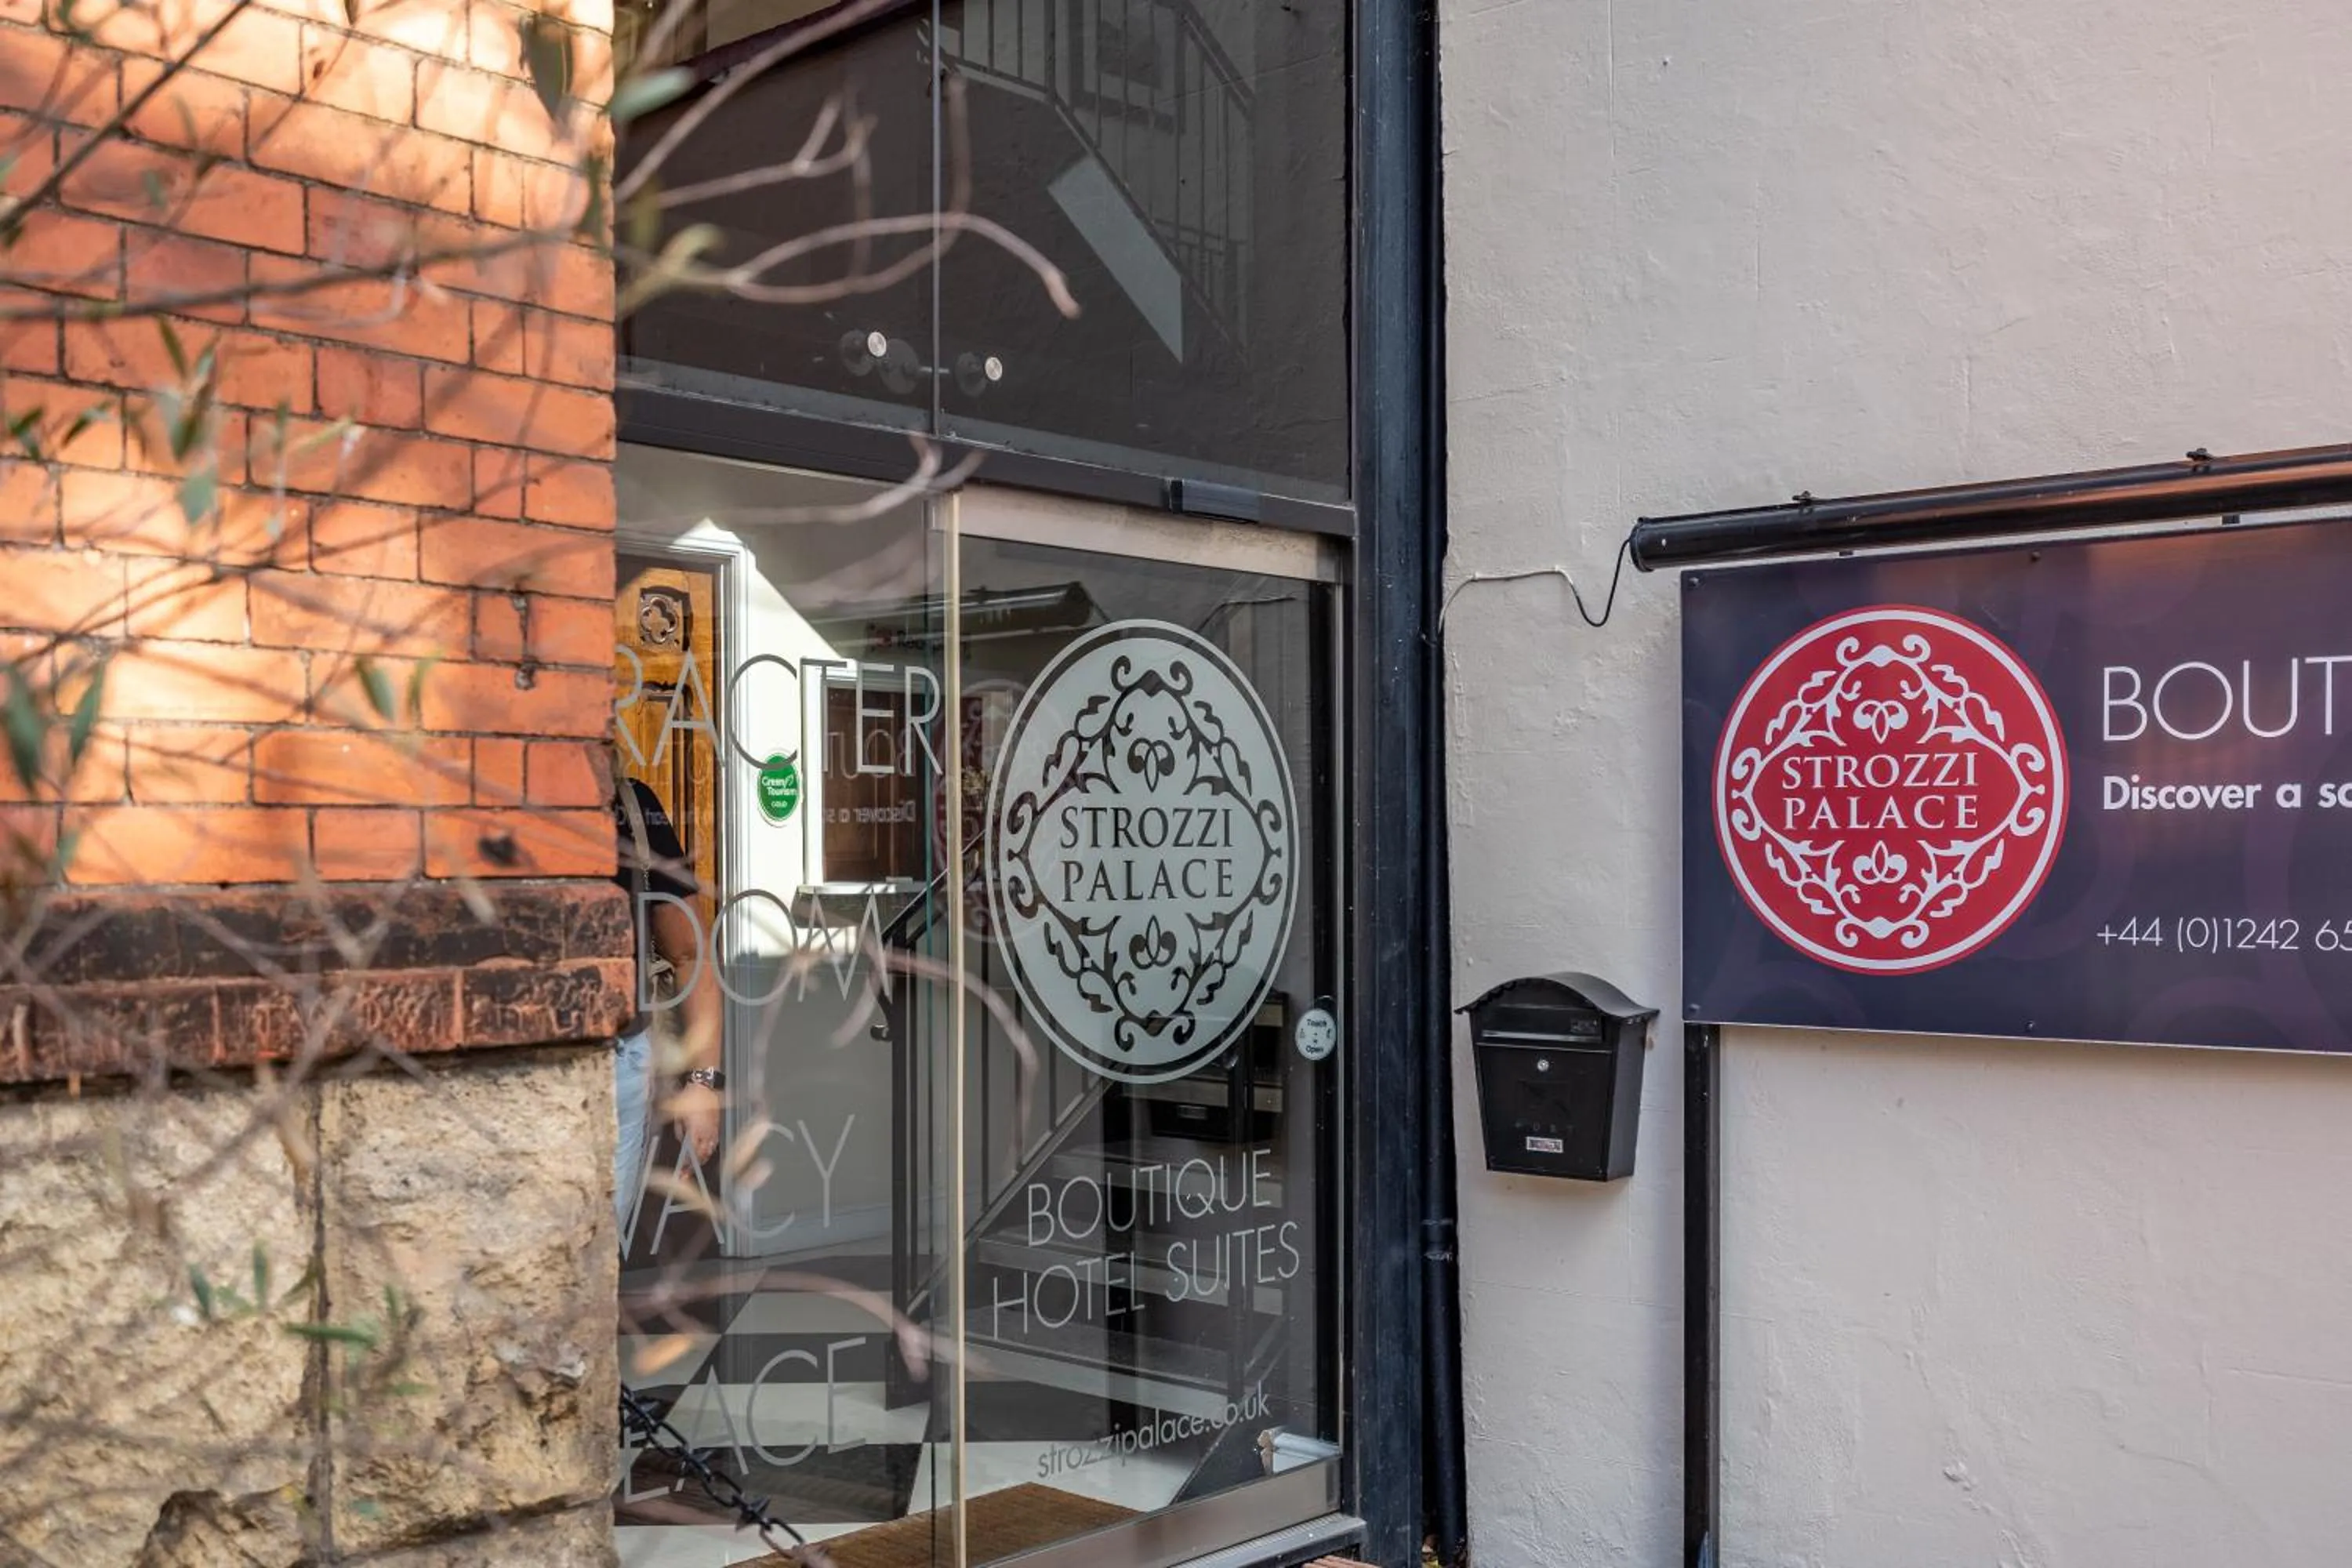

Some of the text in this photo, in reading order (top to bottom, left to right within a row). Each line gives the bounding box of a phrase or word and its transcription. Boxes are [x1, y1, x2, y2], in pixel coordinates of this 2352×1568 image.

[2103, 655, 2352, 741] BOUT
[1782, 752, 1979, 789] STROZZI
[2103, 774, 2262, 810] Discover
[2276, 783, 2302, 809] a
[1060, 806, 1233, 848] STROZZI
[1782, 794, 1979, 829] PALACE
[1062, 858, 1233, 902] PALACE
[2096, 916, 2163, 946] +44
[2177, 916, 2300, 954] (0)1242
[1027, 1148, 1272, 1247] BOUTIQUE
[993, 1221, 1301, 1341] HOTEL SUITES
[1038, 1380, 1271, 1479] strozzipalace.co.uk
